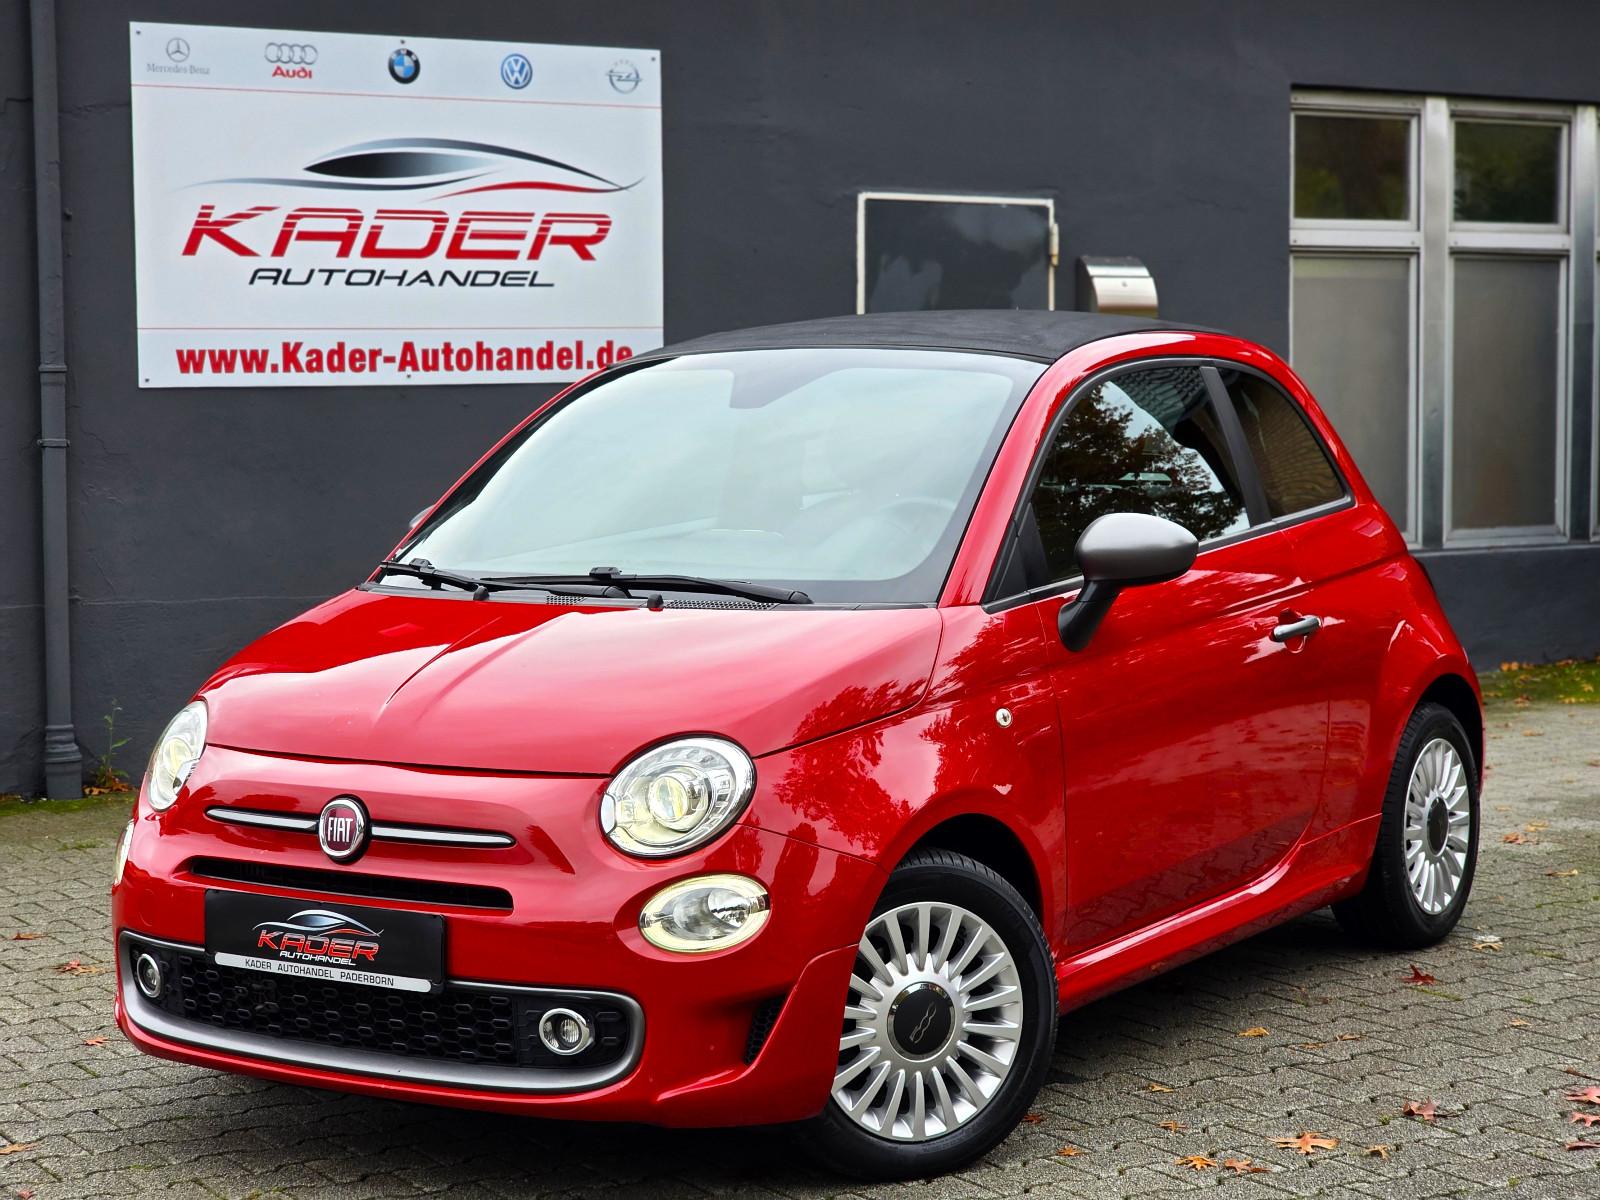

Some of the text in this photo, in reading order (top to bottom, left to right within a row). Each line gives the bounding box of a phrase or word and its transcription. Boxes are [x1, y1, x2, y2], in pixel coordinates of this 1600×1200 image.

[271, 65, 313, 79] Audi
[181, 204, 613, 261] KADER
[248, 267, 555, 287] AUTOHANDEL
[175, 339, 633, 374] www.Kader-Autohandel.de
[327, 816, 354, 843] FIAT
[257, 929, 380, 961] KADER
[279, 950, 357, 966] AUTOHANDEL
[245, 958, 394, 987] KADER AUTOHANDEL PADERBORN
